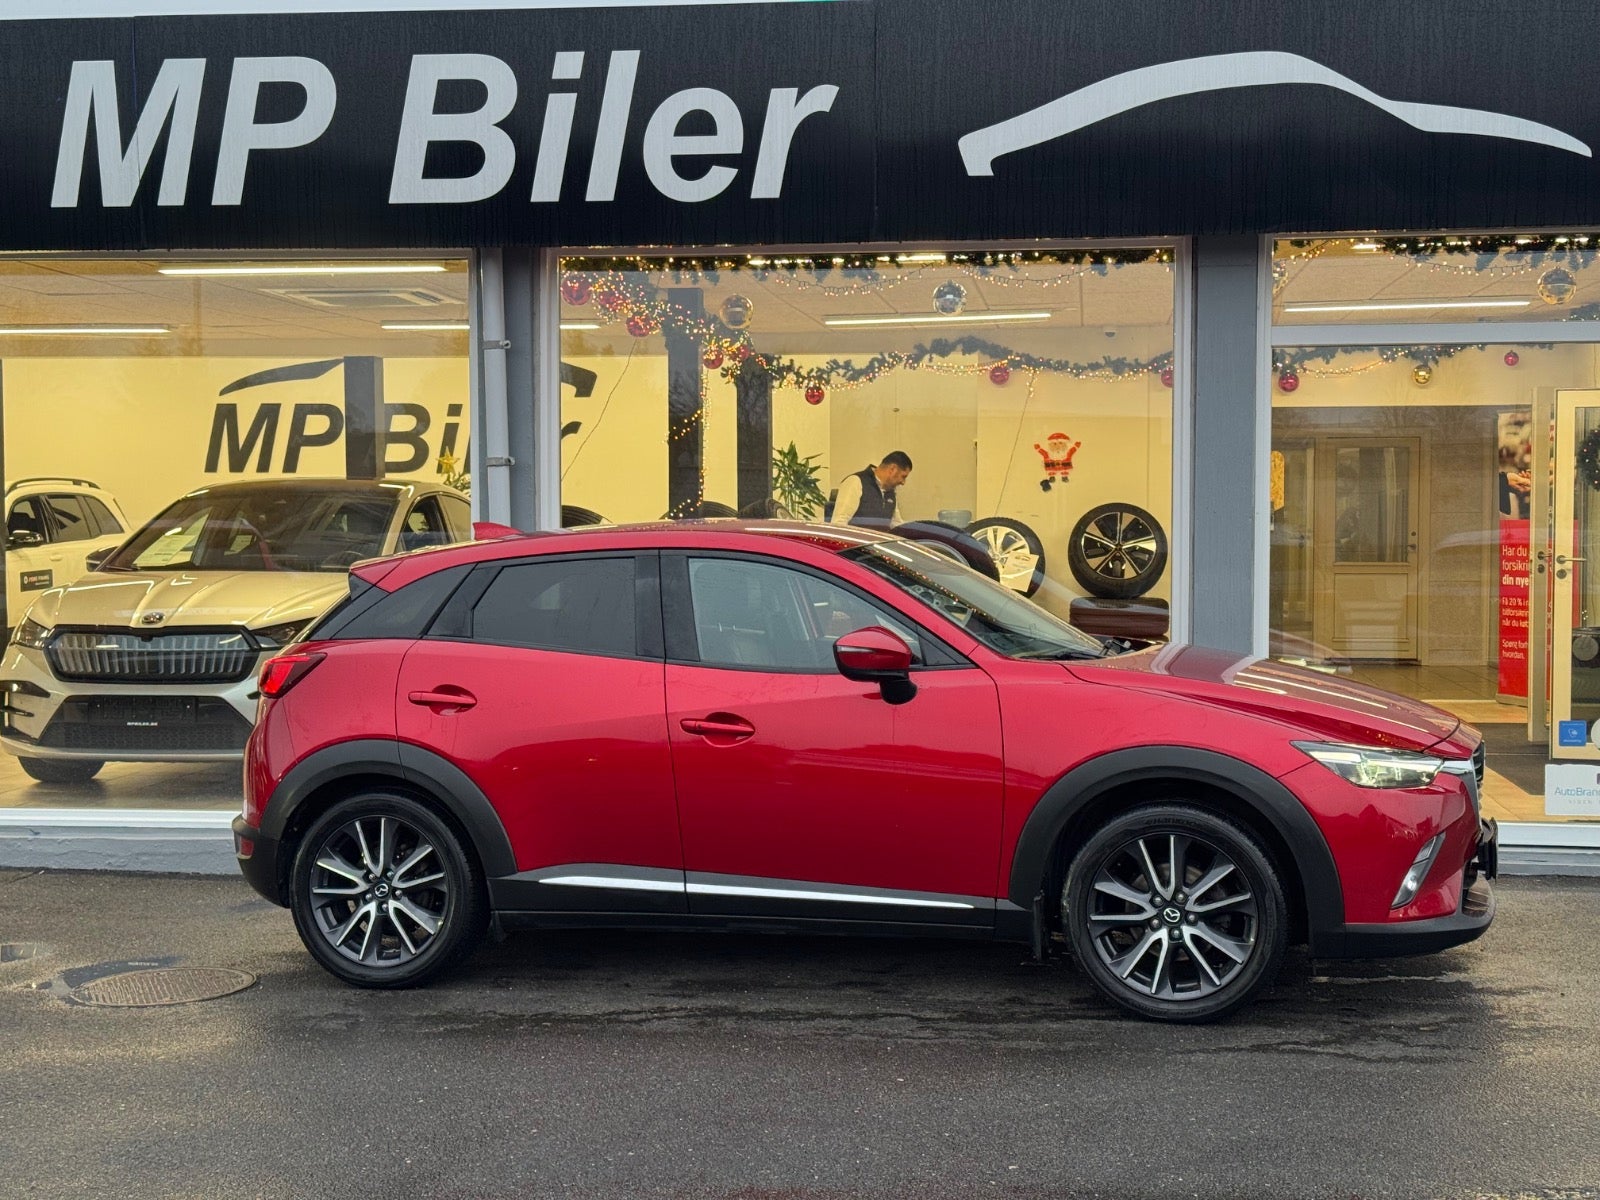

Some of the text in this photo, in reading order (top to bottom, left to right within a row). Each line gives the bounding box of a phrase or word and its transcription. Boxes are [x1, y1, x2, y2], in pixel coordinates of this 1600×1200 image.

[50, 49, 840, 208] MP Biler
[204, 402, 345, 474] MP
[1502, 545, 1527, 557] Har du
[1502, 575, 1529, 589] din nye
[1509, 597, 1517, 606] 20
[1517, 598, 1522, 607] %
